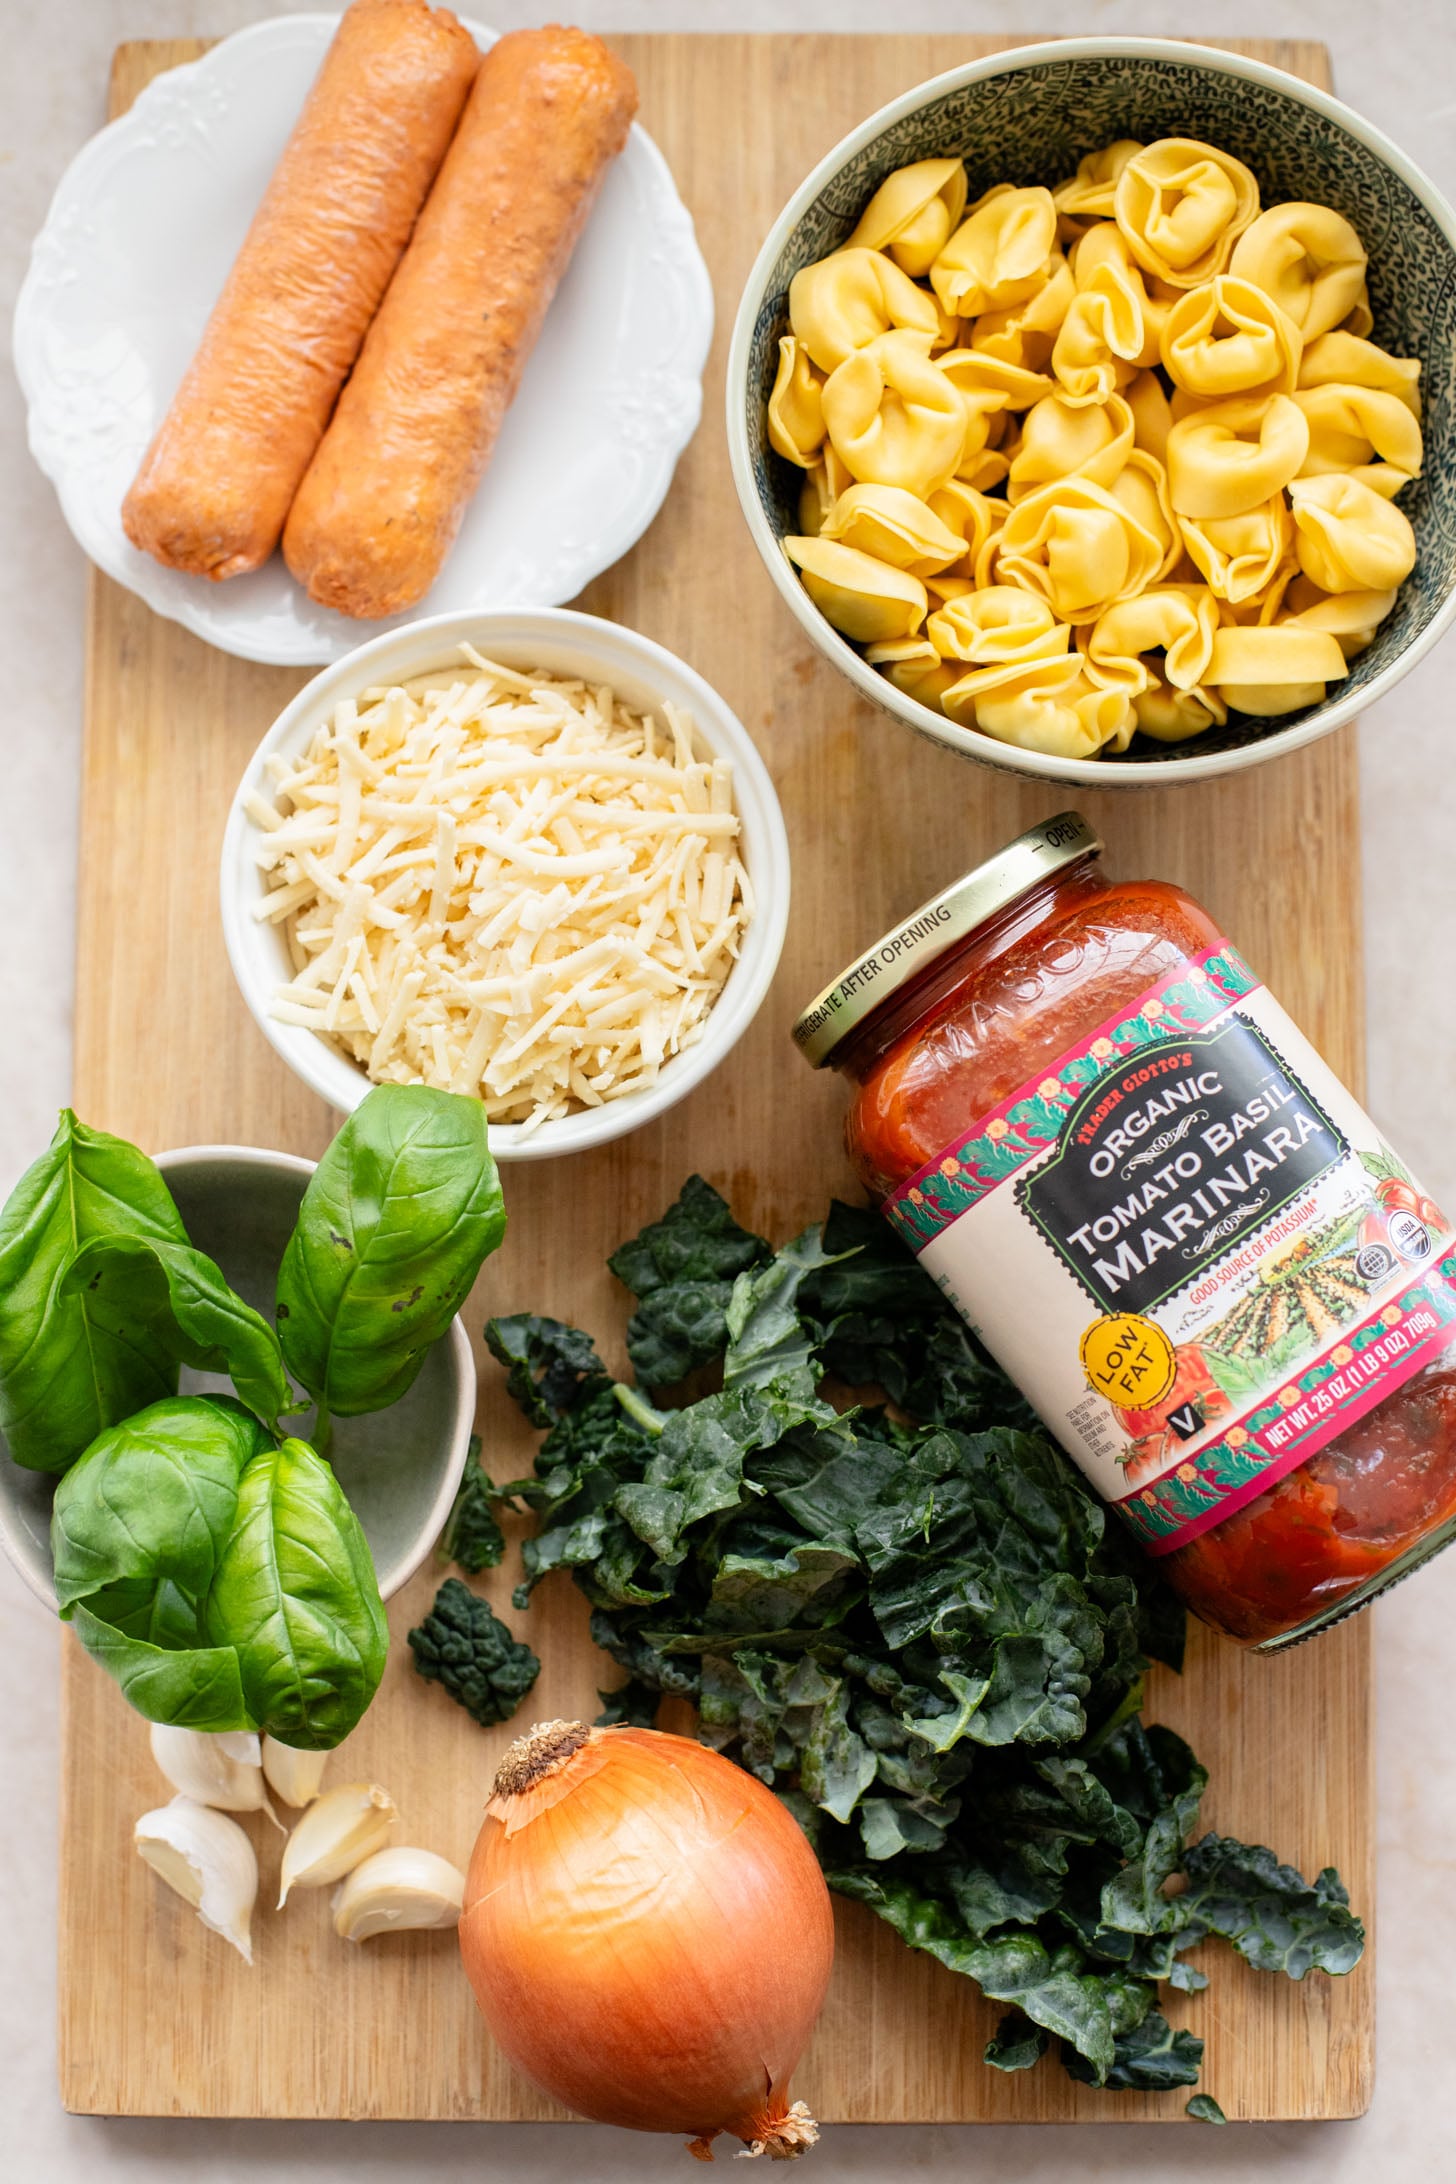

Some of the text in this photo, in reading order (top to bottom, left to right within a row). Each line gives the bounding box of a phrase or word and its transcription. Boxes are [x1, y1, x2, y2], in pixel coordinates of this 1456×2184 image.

[1046, 822, 1082, 848] OPEN
[840, 959, 883, 1001] AFTER
[880, 904, 952, 964] OPENING
[1077, 1052, 1194, 1146] TRADER GIOTTO'S
[1089, 1071, 1223, 1177] ORGANIC
[1066, 1082, 1297, 1256] TOMATO BASIL
[1091, 1111, 1324, 1293] MARINARA
[1190, 1279, 1219, 1306] GOOD
[1216, 1249, 1255, 1288] SOURCE
[1252, 1241, 1268, 1258] OF
[1396, 1220, 1416, 1238] USDA
[1096, 1326, 1139, 1385] LOW
[1265, 1311, 1437, 1448] NET WT. 25 OZ (1 LB 9 OZ) 709g
[1170, 1407, 1196, 1433] V
